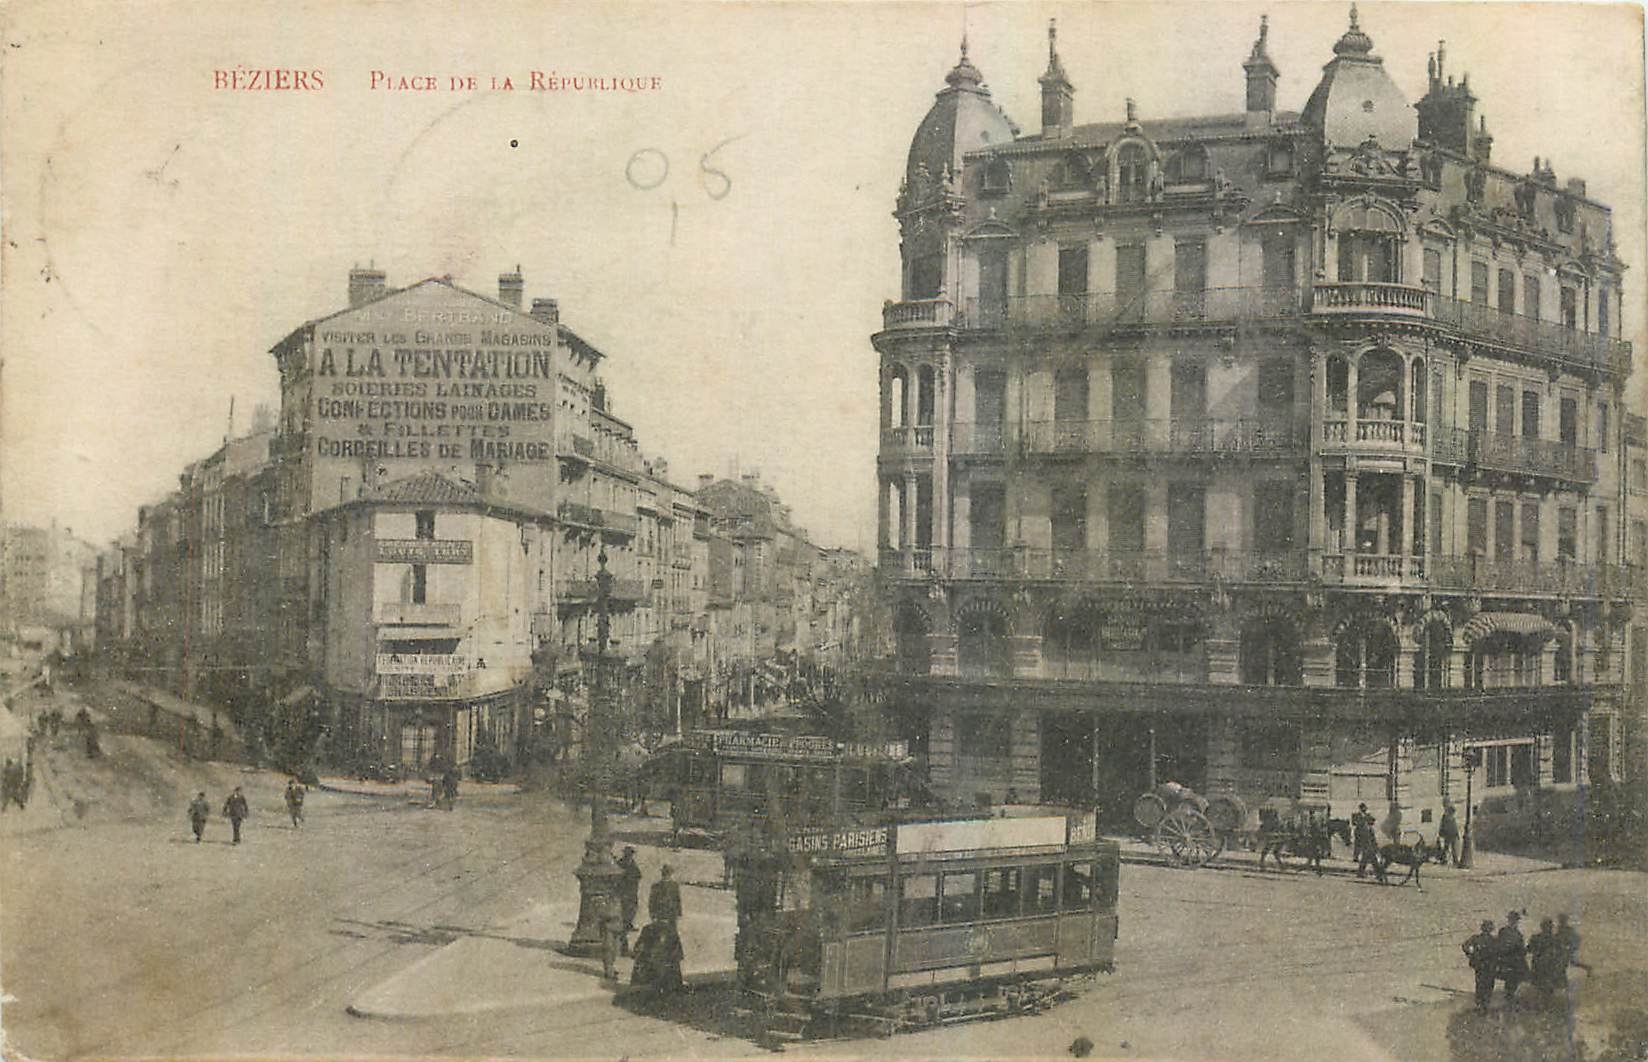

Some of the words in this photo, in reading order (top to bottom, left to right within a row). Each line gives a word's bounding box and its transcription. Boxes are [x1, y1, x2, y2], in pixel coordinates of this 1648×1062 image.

[481, 330, 551, 347] MAGASINS
[319, 349, 336, 377] A
[346, 349, 386, 378] LA
[393, 349, 550, 380] TENTATION
[331, 383, 428, 398] SOIERIES
[436, 383, 537, 399] LAINAGES
[317, 398, 447, 420] CONFECTIONS
[451, 405, 484, 421] POUR
[487, 401, 551, 422] DAMES
[384, 423, 511, 438] FILLETTES
[317, 436, 430, 459] CORBEILLES
[438, 443, 463, 459] DE
[470, 439, 550, 460] MARIAGE
